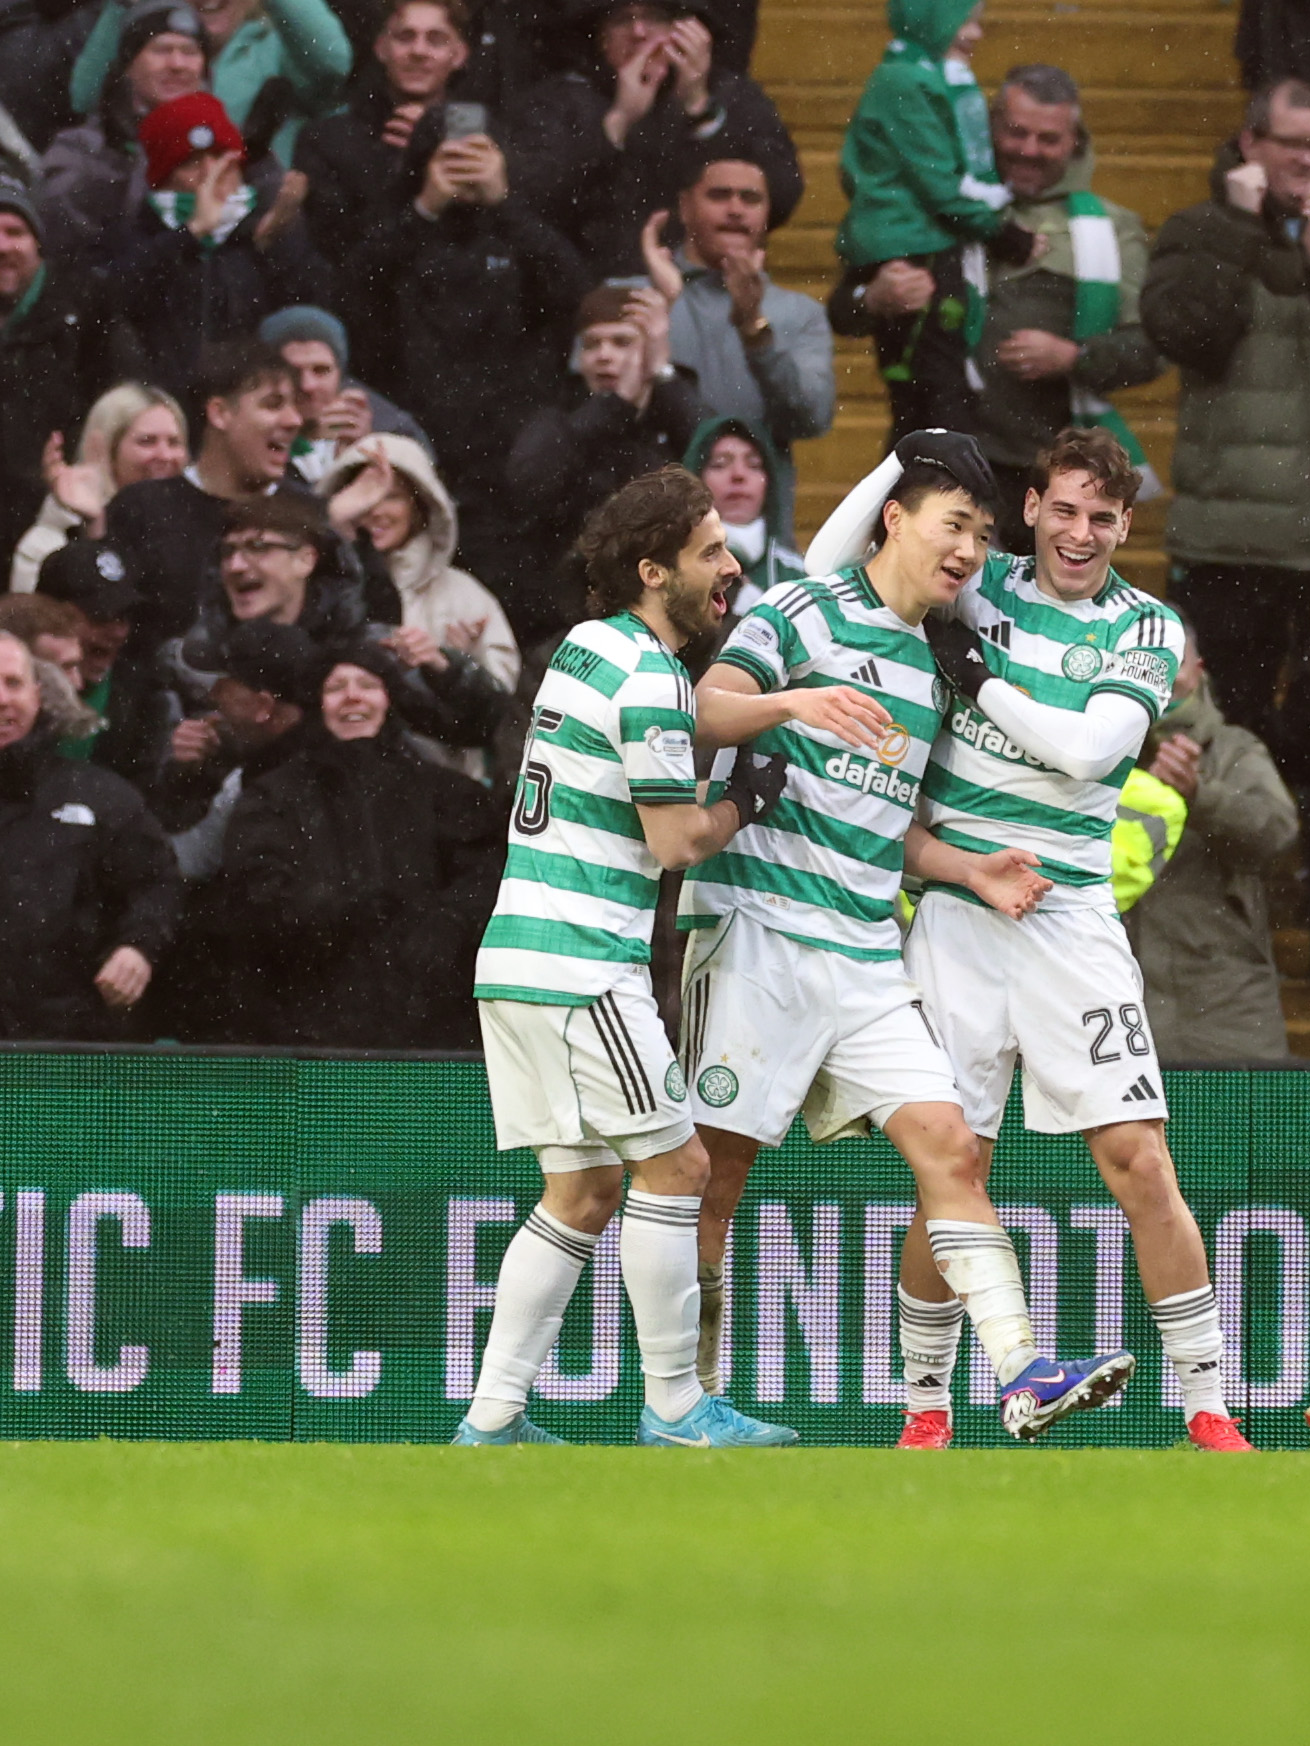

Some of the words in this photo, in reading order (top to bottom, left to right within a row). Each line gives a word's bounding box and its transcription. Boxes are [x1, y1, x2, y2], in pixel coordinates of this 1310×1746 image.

[549, 642, 603, 682] ACCHI
[1125, 651, 1158, 671] CELTIC
[951, 708, 1056, 770] dafab
[825, 752, 920, 808] dafabet
[1082, 1003, 1149, 1066] 28
[0, 1190, 150, 1392] IC
[211, 1193, 383, 1398] FC
